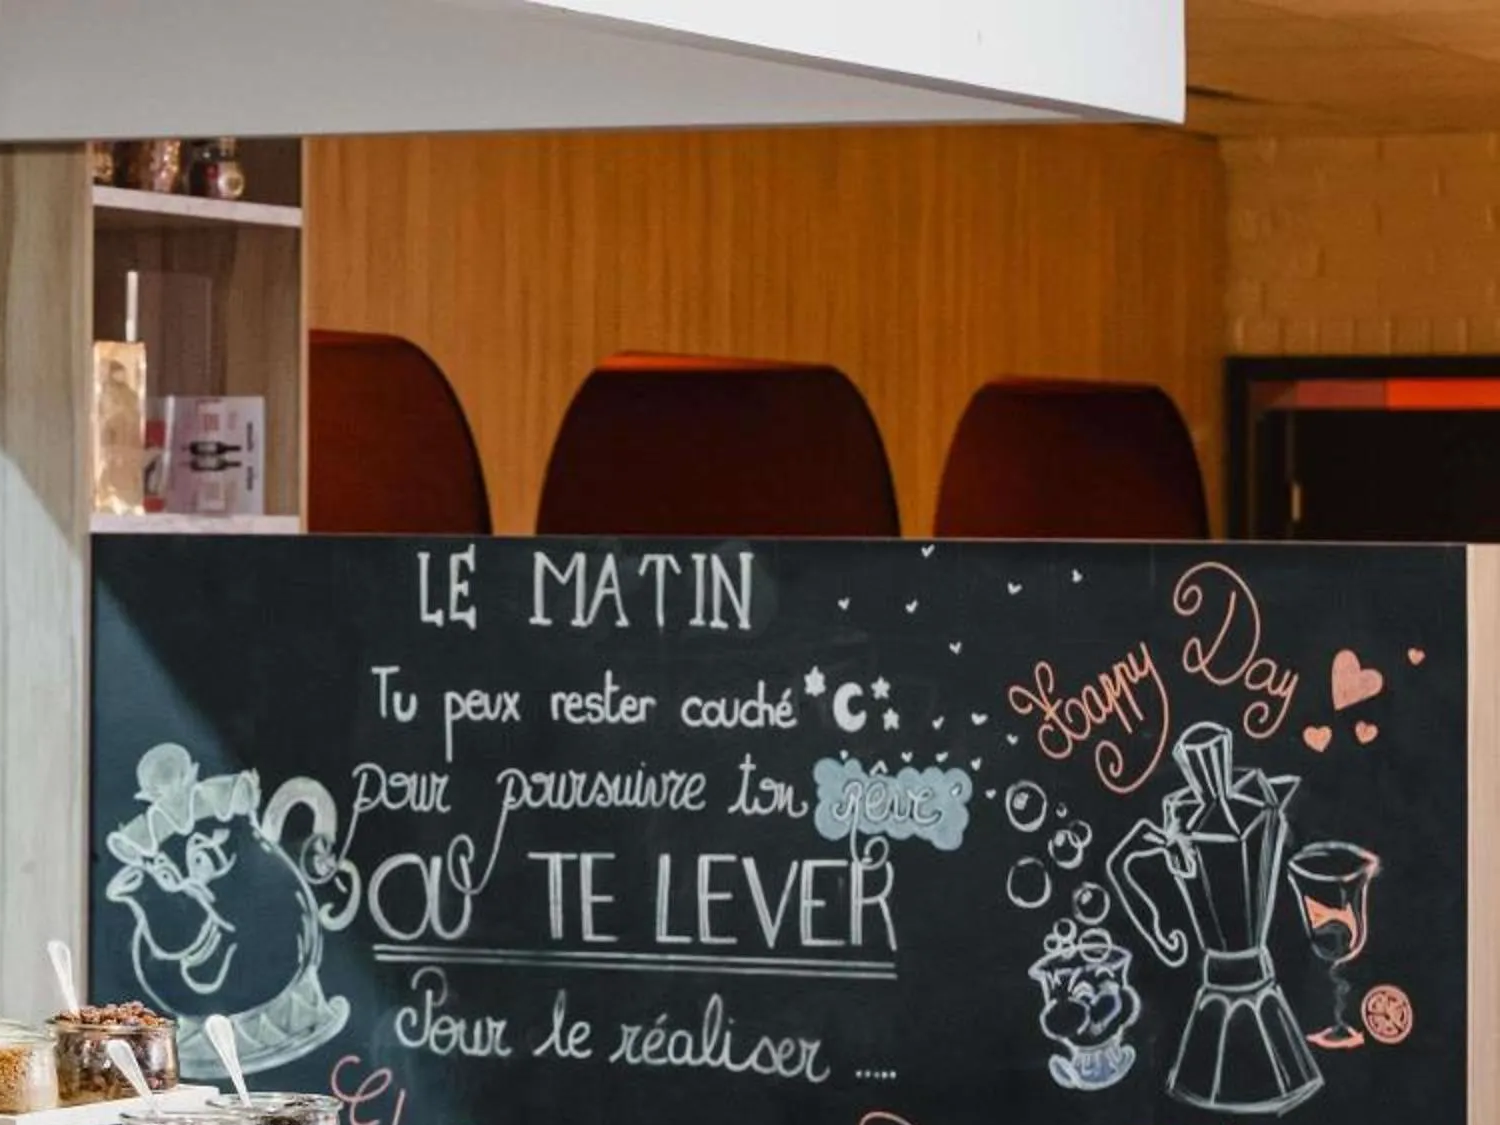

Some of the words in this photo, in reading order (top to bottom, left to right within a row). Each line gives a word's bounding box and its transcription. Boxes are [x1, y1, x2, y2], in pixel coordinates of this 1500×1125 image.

[416, 543, 477, 630] LE
[528, 551, 755, 630] MATIN
[1173, 560, 1299, 740] Day
[371, 665, 418, 722] Tu
[444, 687, 521, 763] peux
[550, 669, 657, 725] rester
[680, 679, 798, 729] couché
[1008, 637, 1169, 794] Happy
[727, 752, 810, 819] ton
[527, 851, 619, 942] TE
[655, 852, 898, 952] LEVER
[394, 966, 513, 1056] Pour
[532, 989, 592, 1059] le
[608, 993, 831, 1084] réaliser
